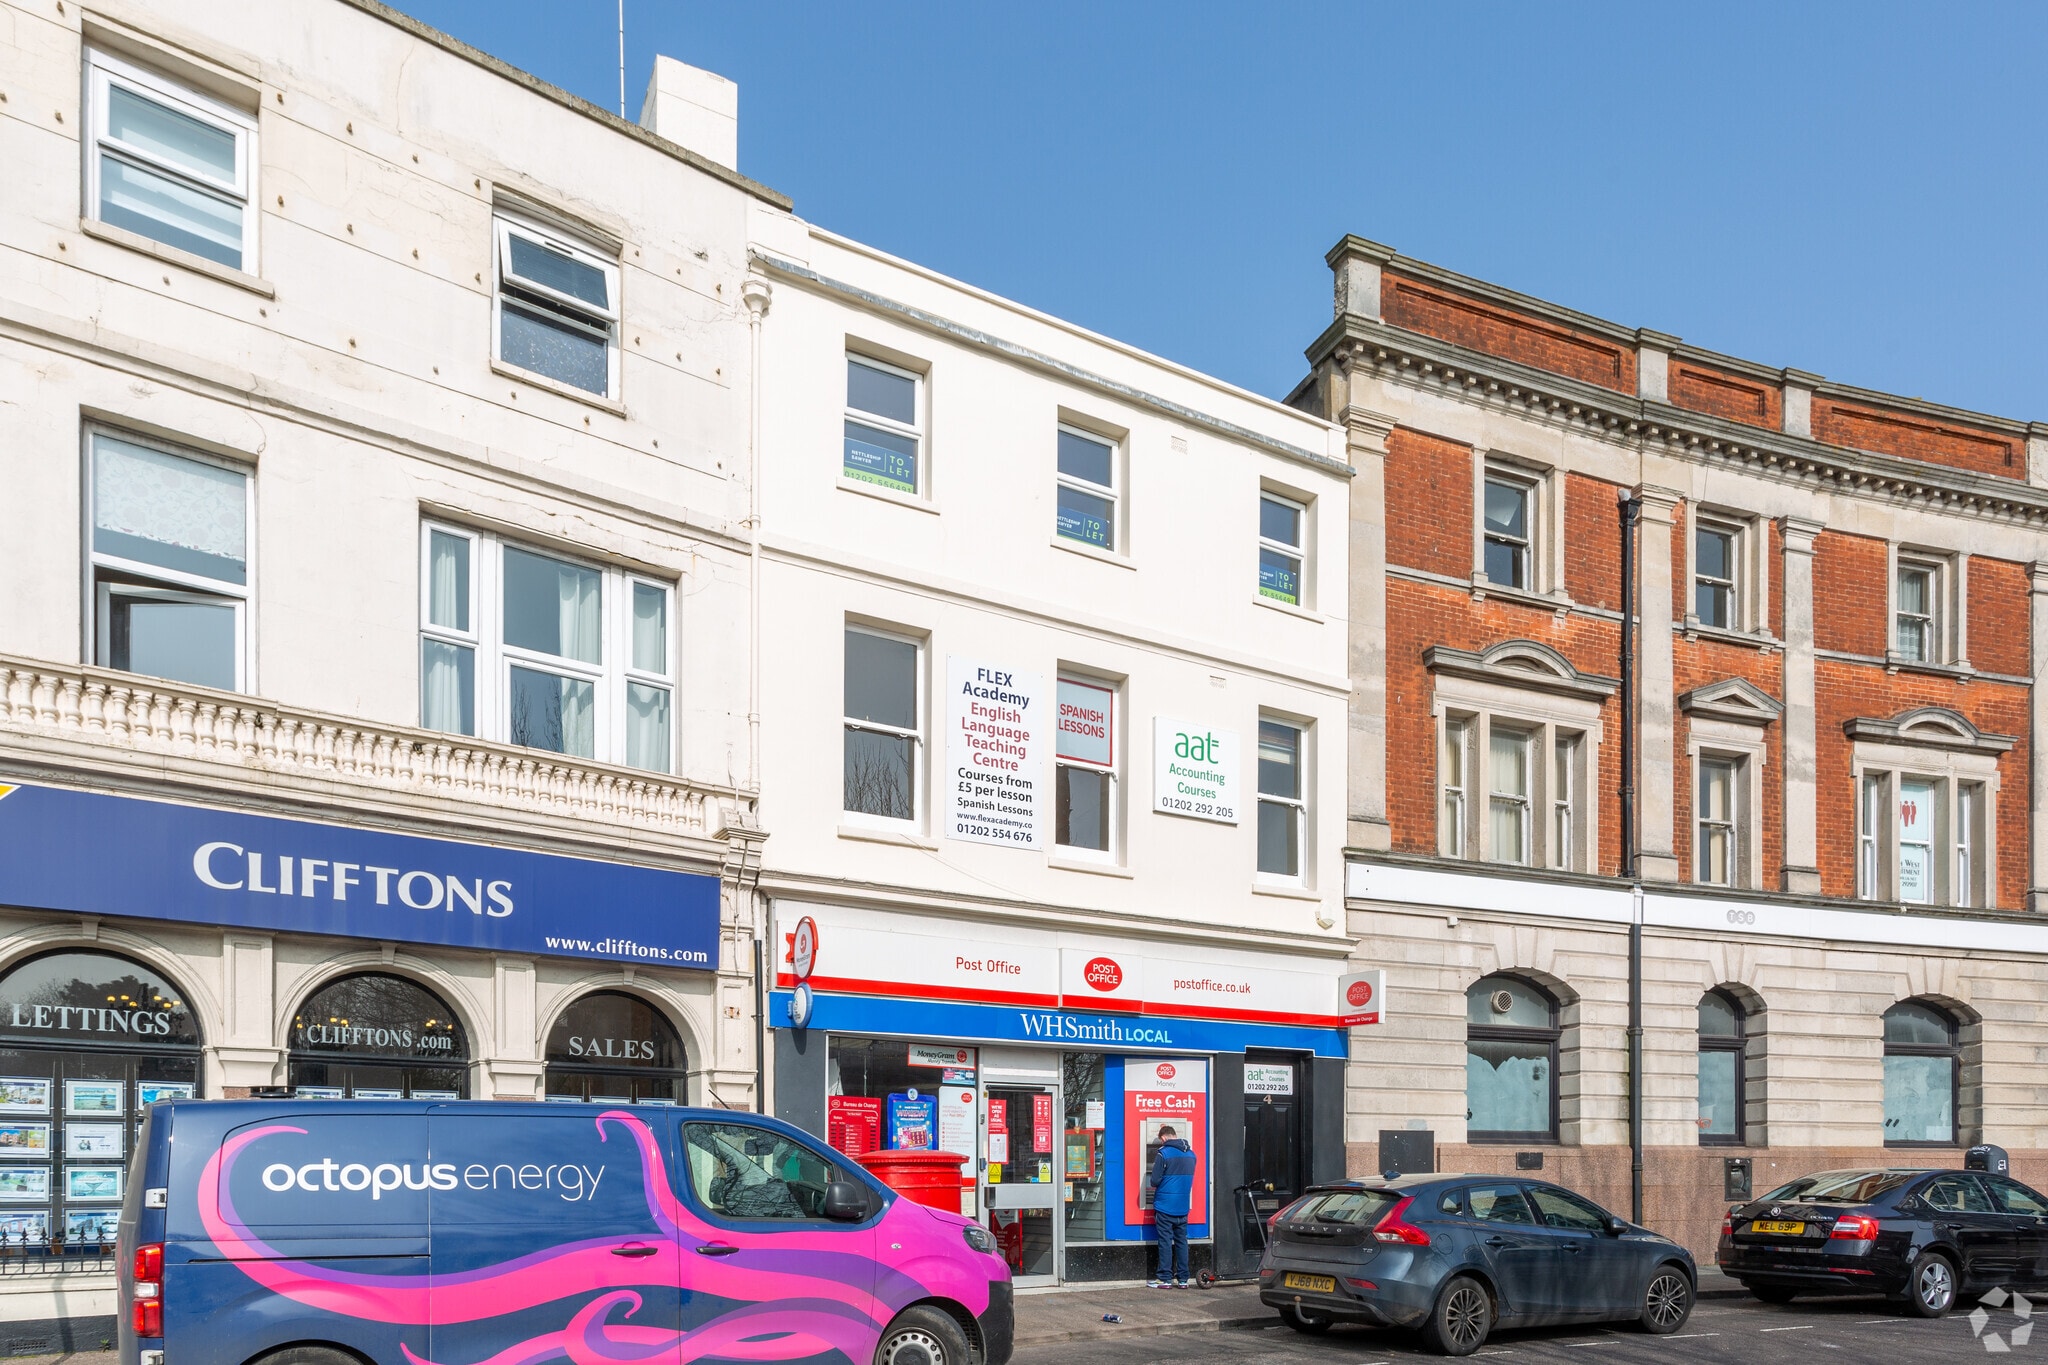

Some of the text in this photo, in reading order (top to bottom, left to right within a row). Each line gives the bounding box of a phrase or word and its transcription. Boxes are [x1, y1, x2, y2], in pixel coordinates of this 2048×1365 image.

[889, 455, 904, 467] TO
[844, 470, 873, 484] 01202
[889, 465, 910, 478] LET
[1087, 520, 1100, 530] TO
[1086, 529, 1104, 542] LET
[1279, 572, 1289, 582] TO
[1279, 580, 1293, 591] LET
[977, 667, 1012, 687] FLEX
[962, 681, 1030, 710] Academy
[971, 702, 1021, 723] English
[1059, 703, 1104, 723] SPANISH
[961, 716, 1030, 743] Language
[1058, 718, 1105, 739] LESSONS
[964, 733, 1026, 760] Teaching
[1174, 731, 1219, 764] aat
[973, 752, 1018, 771] Centre
[957, 767, 1033, 789] Courses from
[1169, 763, 1225, 786] Accounting
[958, 781, 1033, 803] £5 per lesson
[1177, 782, 1216, 799] Courses
[957, 797, 1033, 817] Spanish Lessons
[1162, 796, 1233, 818] 01202 292 205
[956, 811, 1033, 830] www.flexacademy.co
[957, 823, 1032, 842] 01202 554 676
[193, 841, 514, 918] CLIFFTONS
[1728, 911, 1754, 924] TSB
[545, 936, 708, 963] www.clifftons.com
[956, 956, 1021, 975] Post Office
[1092, 963, 1115, 975] POST
[1087, 972, 1118, 985] OFFICE
[1173, 977, 1251, 994] postoffice.co.uk
[1349, 993, 1368, 1001] OFFICE
[10, 1003, 170, 1036] LETTINGS
[1020, 1013, 1173, 1044] WHSmith LOCAL
[307, 1025, 452, 1050] CLIFFTONS .com
[569, 1036, 655, 1060] SALES
[917, 1050, 955, 1060] MoneyGram
[1157, 1080, 1176, 1088] Money
[1248, 1069, 1264, 1081] aat
[1135, 1094, 1196, 1108] Free Cash
[1263, 1094, 1272, 1104] 4
[262, 1158, 605, 1201] octopus energy
[1289, 1225, 1342, 1233] VOLVO
[1778, 1222, 1797, 1231] 69P
[1290, 1274, 1331, 1290] YJ68 NXC
